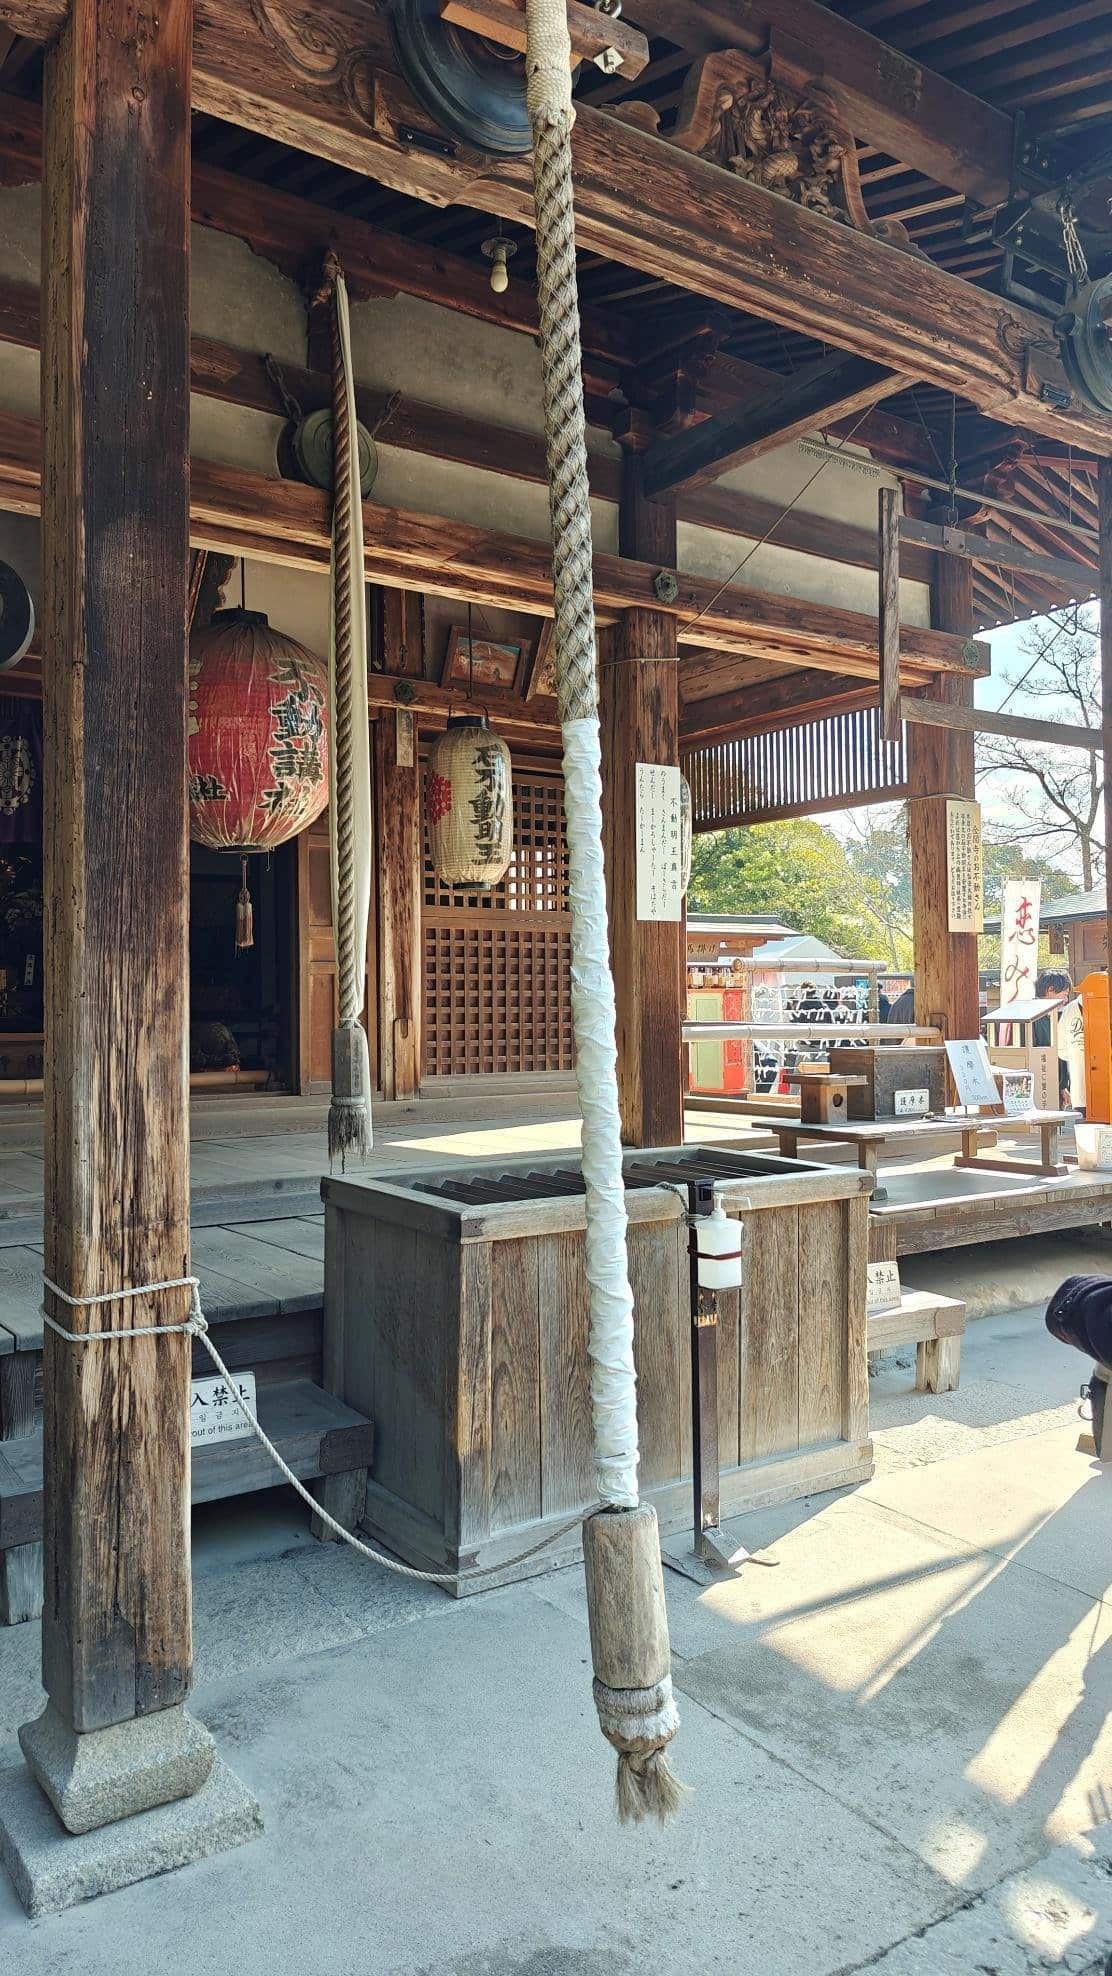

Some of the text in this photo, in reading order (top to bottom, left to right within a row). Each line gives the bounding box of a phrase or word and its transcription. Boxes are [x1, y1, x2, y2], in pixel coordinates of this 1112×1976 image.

[669, 796, 679, 895] 不動明王真言
[191, 1427, 206, 1437] out
[207, 1425, 216, 1435] of
[218, 1423, 233, 1433] this
